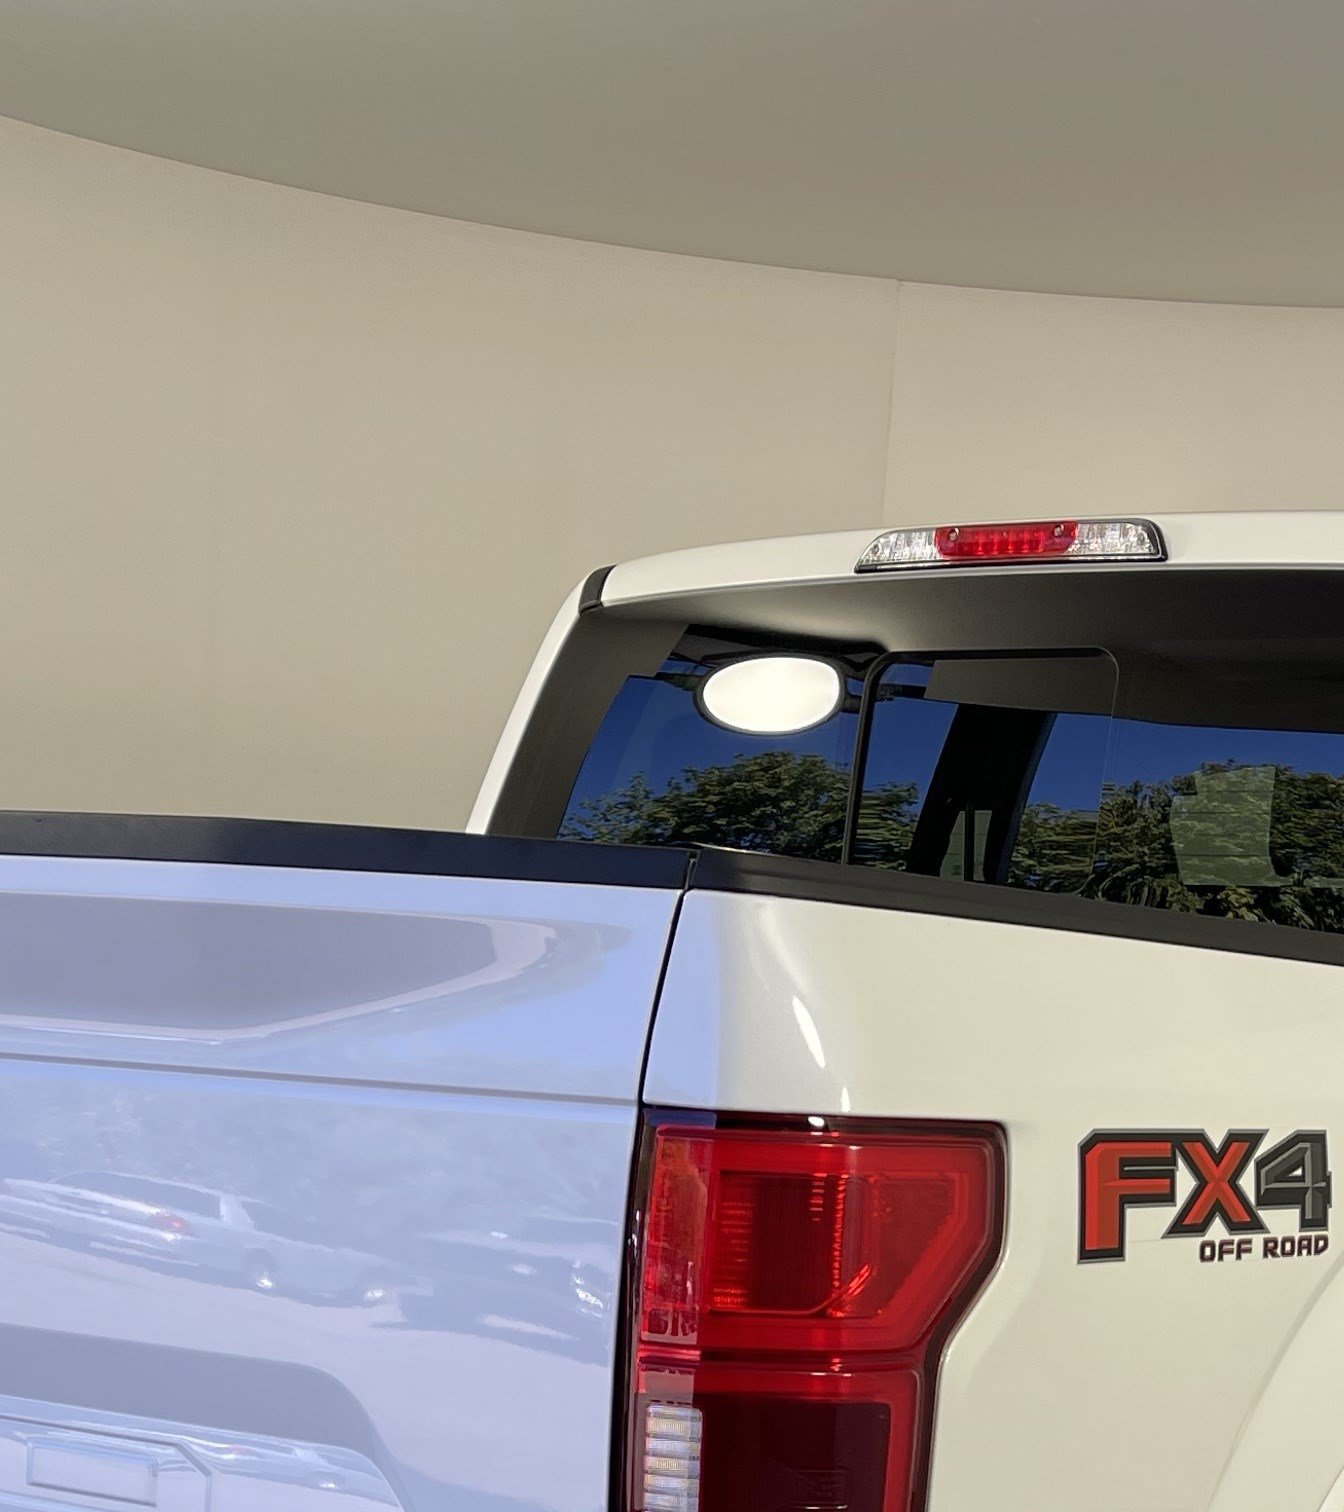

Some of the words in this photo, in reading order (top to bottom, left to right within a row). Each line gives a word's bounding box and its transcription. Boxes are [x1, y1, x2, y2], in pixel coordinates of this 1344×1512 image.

[1077, 1128, 1332, 1265] FX4
[1198, 1237, 1253, 1263] OFF
[1262, 1234, 1330, 1260] ROAD
